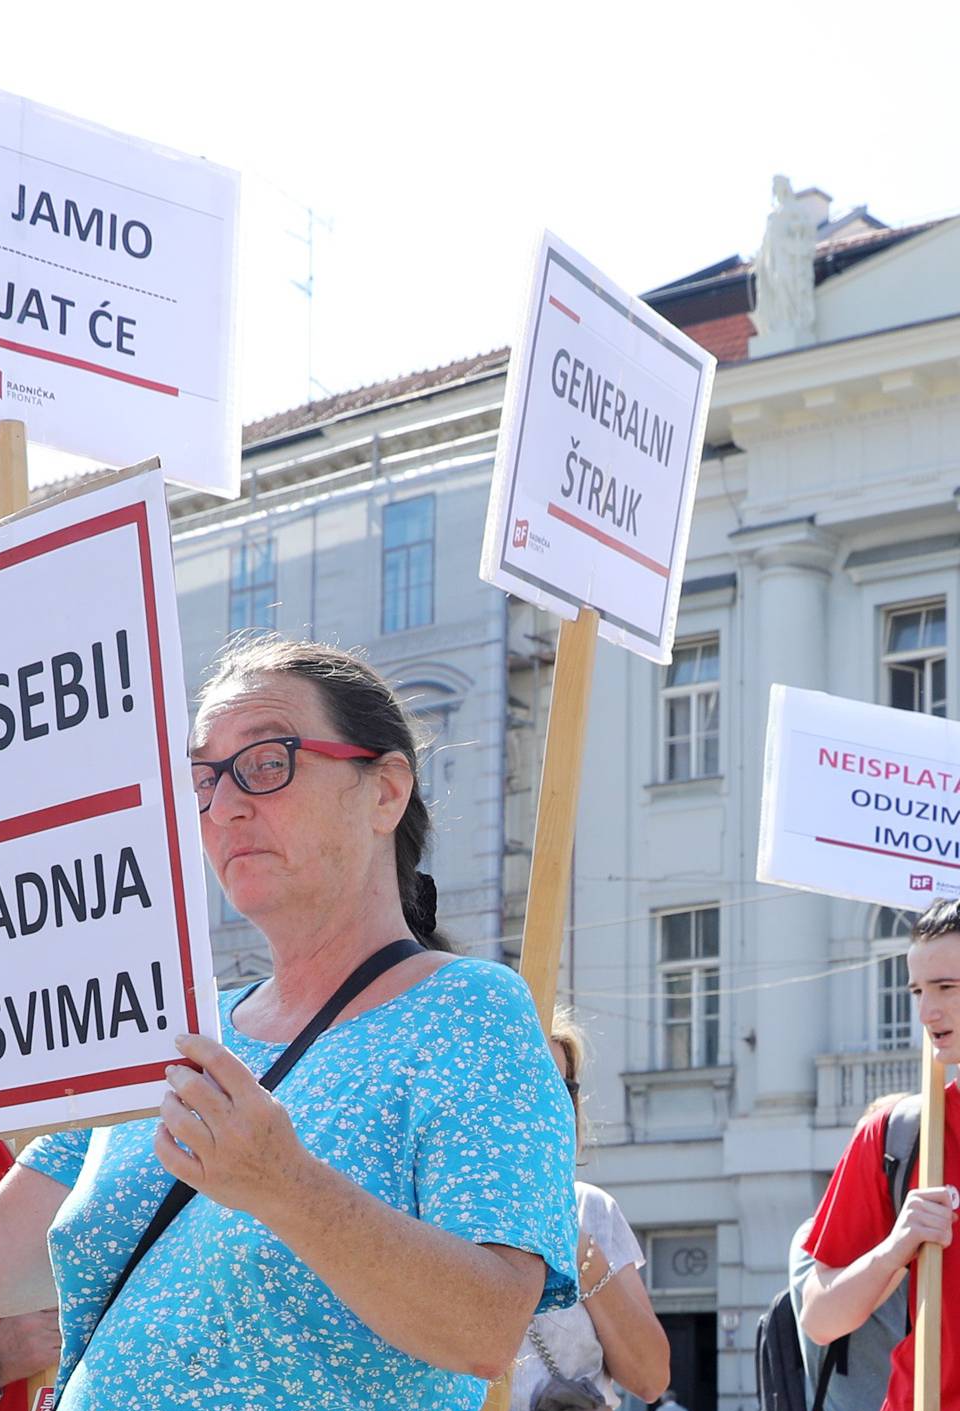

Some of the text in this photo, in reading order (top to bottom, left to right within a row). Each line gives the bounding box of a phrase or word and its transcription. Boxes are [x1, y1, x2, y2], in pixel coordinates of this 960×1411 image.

[11, 184, 153, 259] JAMIO
[89, 301, 136, 356] ĆE
[6, 381, 56, 400] RADNIČKA
[551, 348, 675, 467] GENERALNI
[561, 436, 642, 537] ŠTRAJK
[875, 826, 959, 858] IMOVI
